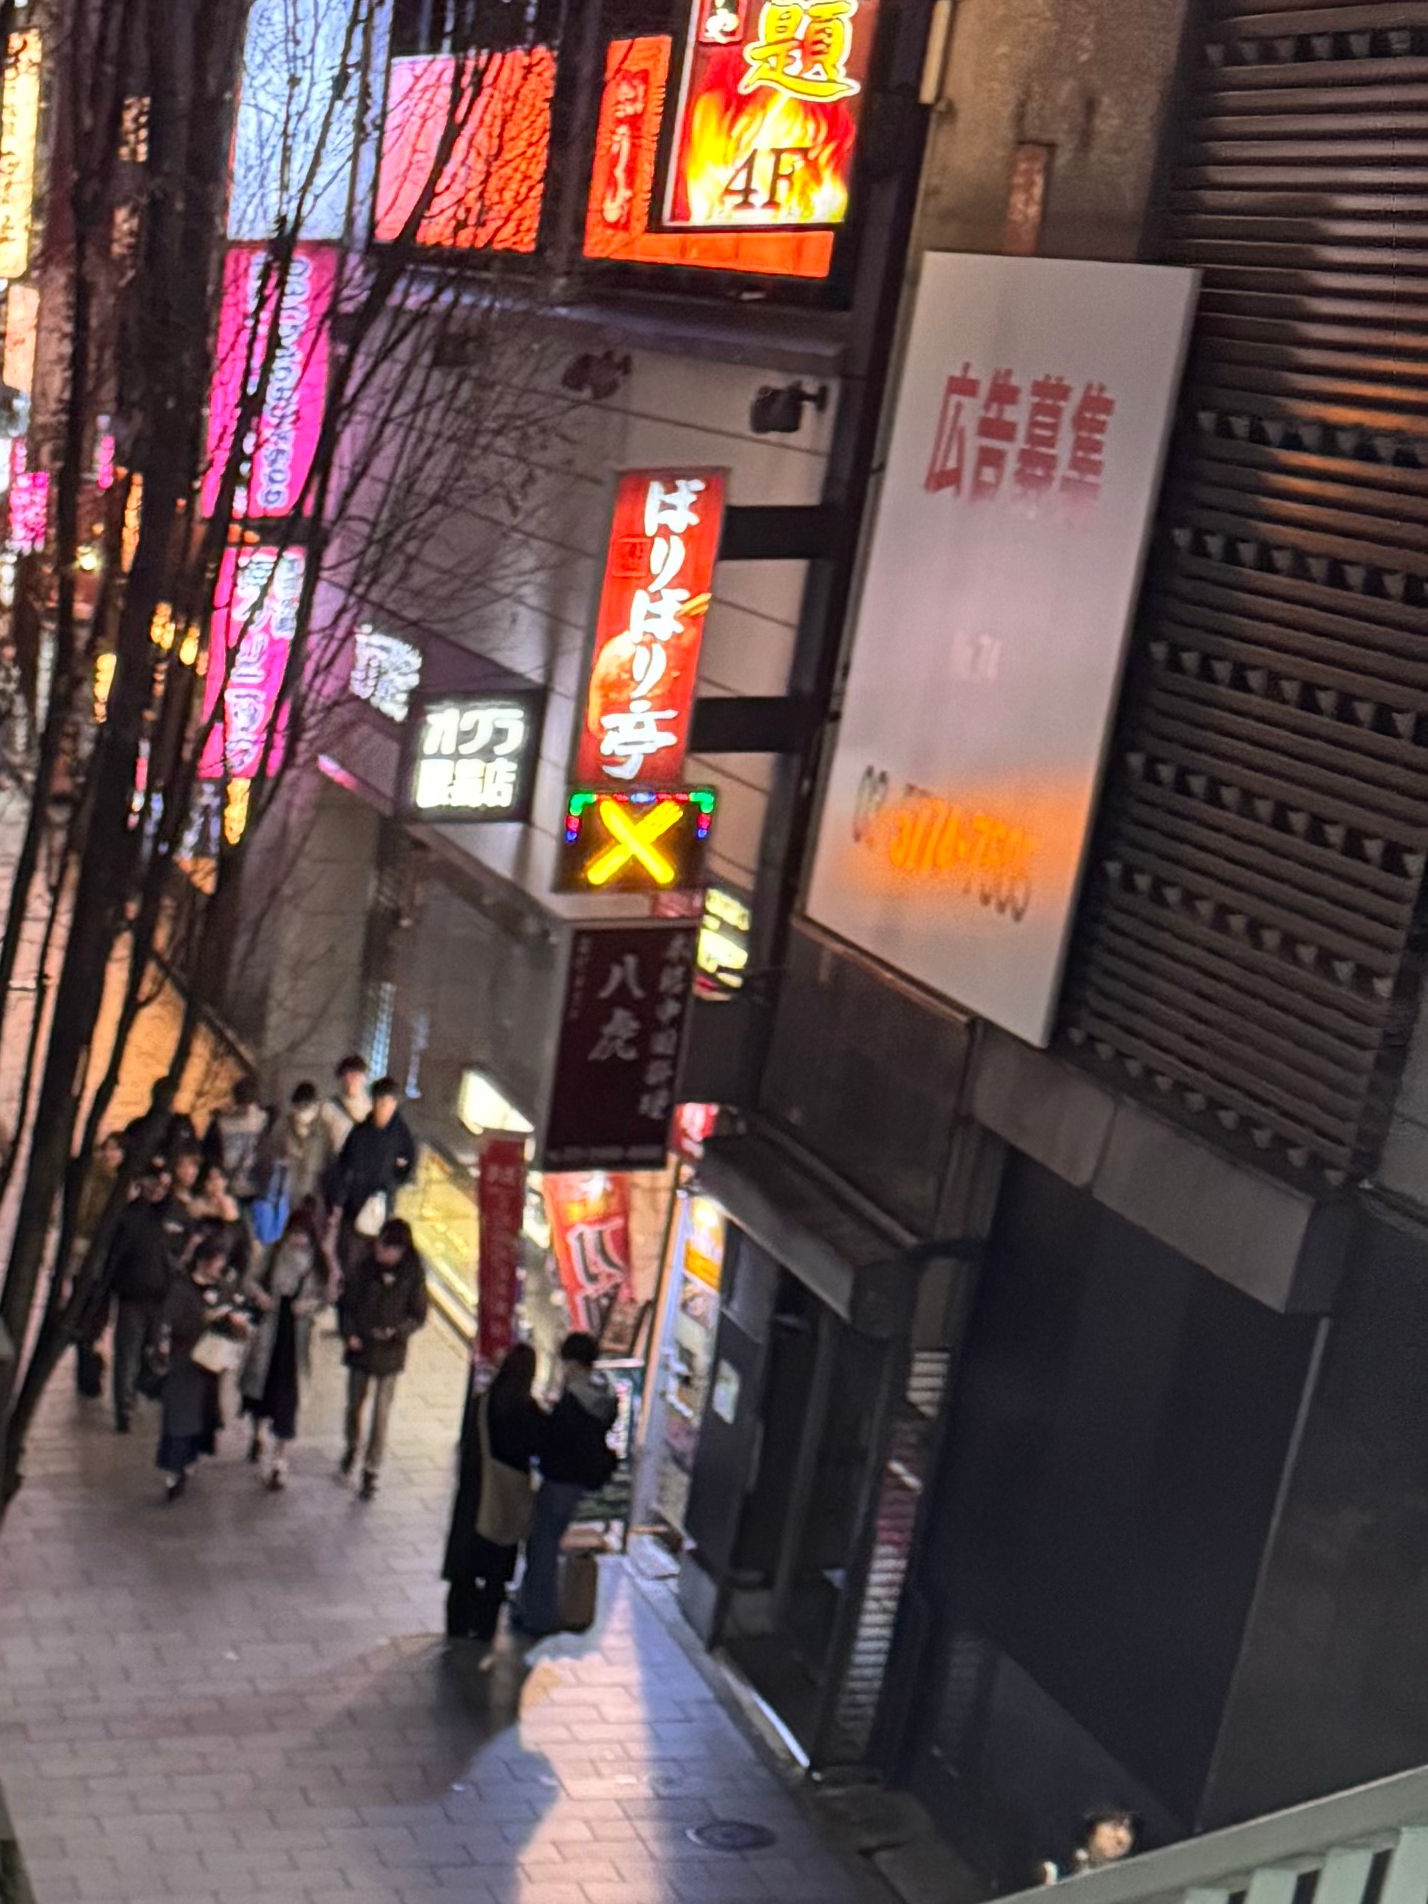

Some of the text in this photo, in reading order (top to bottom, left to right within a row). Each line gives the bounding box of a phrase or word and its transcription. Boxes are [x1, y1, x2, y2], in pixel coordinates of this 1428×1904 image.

[723, 147, 812, 209] 4F
[924, 361, 1116, 502] 広告募集
[422, 707, 525, 755] オクラ
